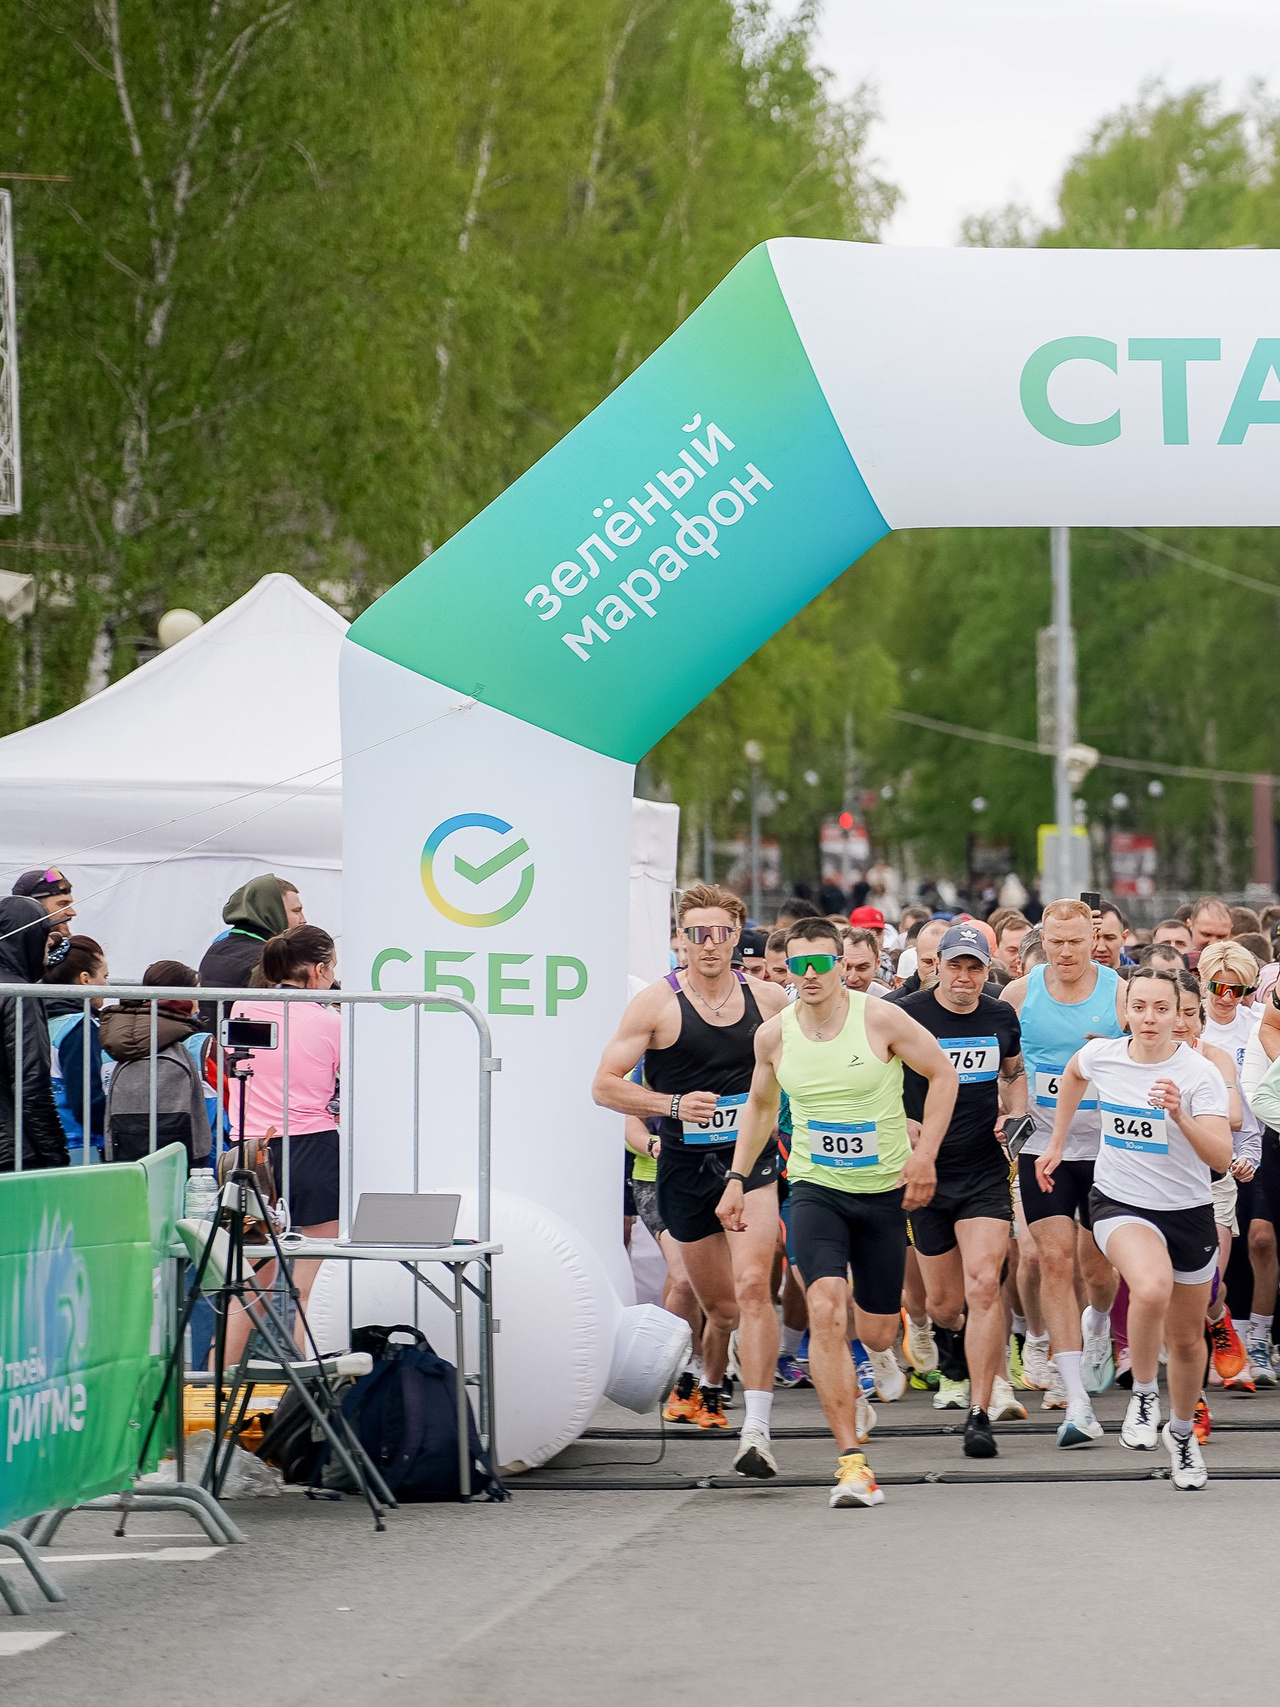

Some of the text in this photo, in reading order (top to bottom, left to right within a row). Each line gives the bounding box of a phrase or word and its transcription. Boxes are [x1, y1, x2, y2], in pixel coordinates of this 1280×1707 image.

[524, 412, 736, 621] зелёный
[561, 461, 774, 663] марафон
[370, 947, 589, 1017] СБЕР
[950, 1050, 986, 1069] 767
[822, 1135, 863, 1154] 803
[1114, 1117, 1153, 1138] 848
[6, 1383, 87, 1462] ритме
